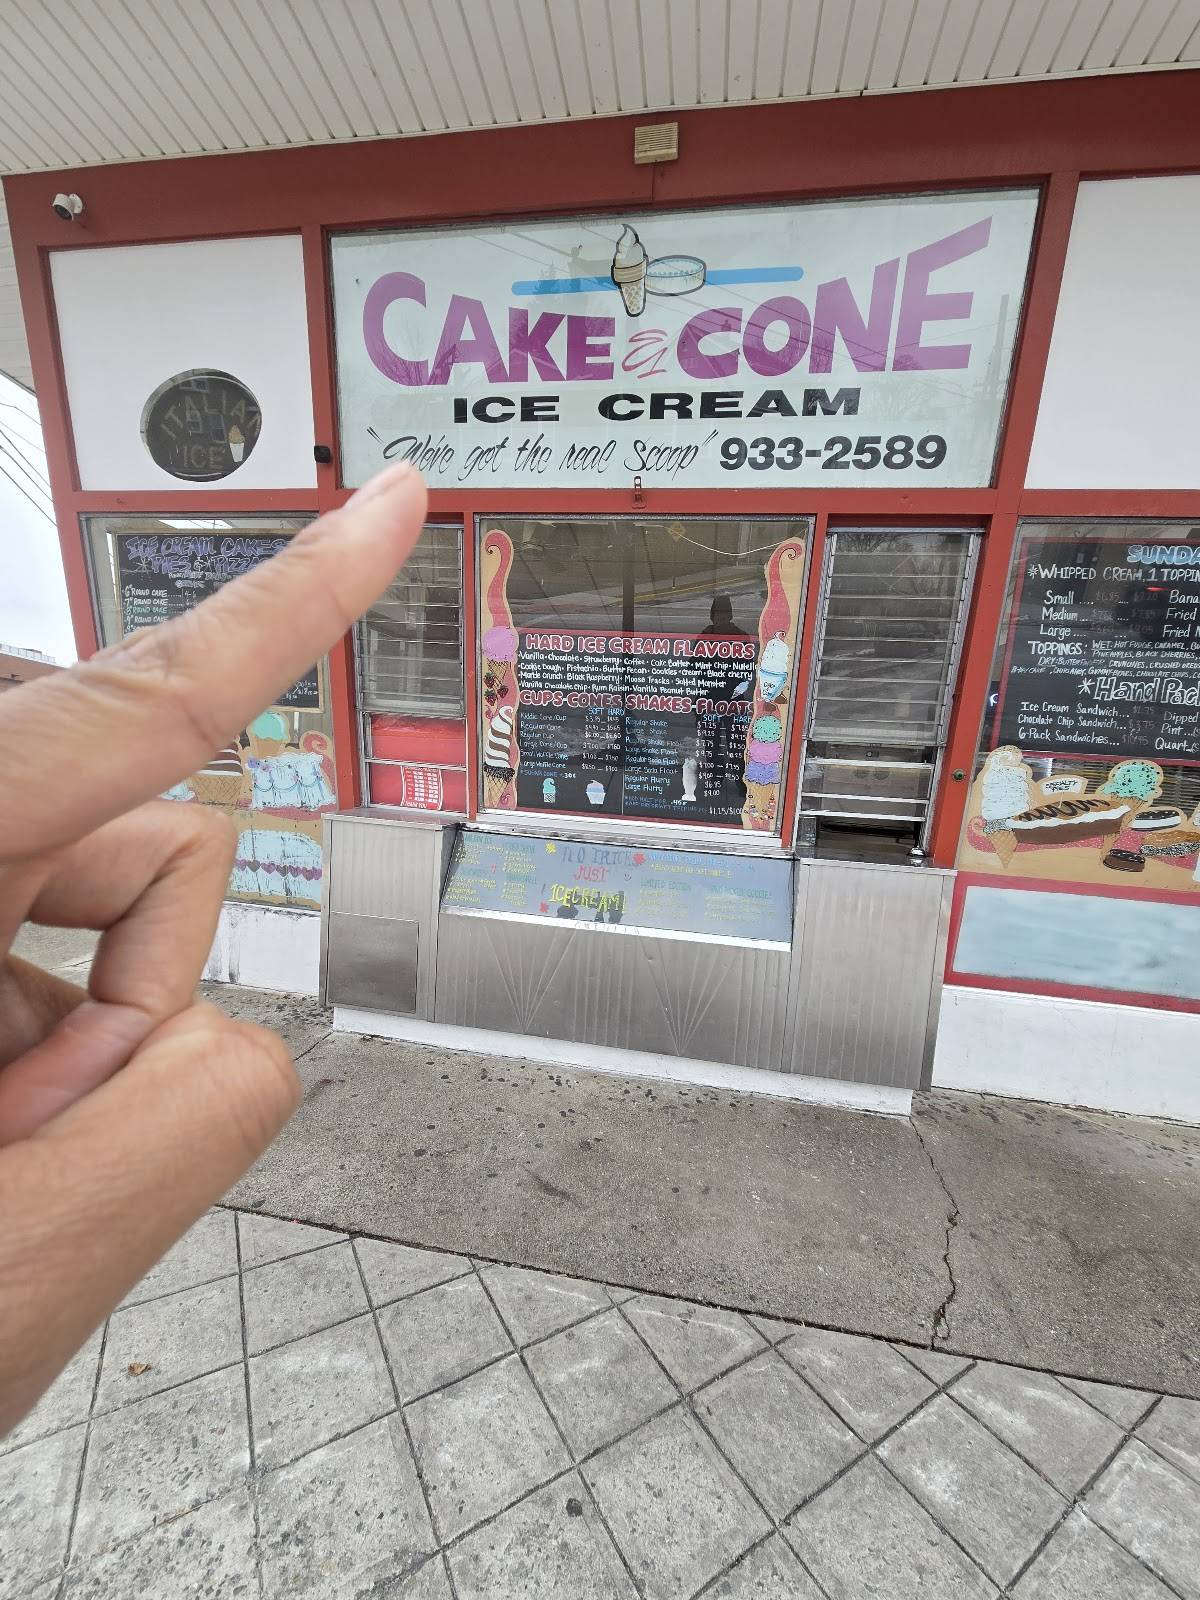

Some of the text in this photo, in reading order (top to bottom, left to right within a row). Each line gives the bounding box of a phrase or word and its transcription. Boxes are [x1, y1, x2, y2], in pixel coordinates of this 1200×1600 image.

[362, 271, 615, 387] CAKE
[676, 216, 993, 379] CONE
[453, 387, 862, 424] ICE CREAM
[459, 437, 506, 479] got
[514, 433, 558, 475] the
[560, 433, 612, 476] real
[719, 435, 948, 472] 933-2589
[127, 536, 158, 560] ICE
[160, 536, 217, 556] CREAM
[151, 589, 167, 597] CAKE
[1043, 590, 1074, 605] Small
[152, 598, 168, 606] CAKE
[1041, 606, 1078, 621] Medium
[1165, 607, 1197, 621] Fried
[1040, 623, 1072, 640] Large
[1162, 624, 1191, 638] Fried
[526, 633, 756, 660] HARD ICE CREAM FLAVORS
[519, 651, 545, 661] Vanilla
[548, 652, 579, 662] Chocolate
[584, 655, 621, 665] Strawberry
[624, 658, 646, 666] Coffee
[651, 658, 667, 667] Cake
[668, 658, 691, 668] Batter
[695, 661, 713, 669] Mint
[714, 661, 730, 670] Chip
[1150, 661, 1180, 669] CRUSHED
[520, 662, 541, 671] Cookie
[543, 663, 562, 673] Dough
[567, 664, 599, 673] Pistachio
[603, 664, 626, 673] Butter
[627, 666, 648, 675] Pecan
[651, 666, 678, 676] Cookies
[706, 670, 726, 678] Black
[520, 671, 541, 680] Marble
[567, 673, 586, 681] Black
[586, 673, 620, 684] Raspberry
[624, 675, 646, 683] Moose
[647, 675, 670, 684] Tracks
[520, 680, 543, 689] Vanilla
[544, 682, 573, 690] Chocolate
[592, 683, 608, 692] Rum
[608, 684, 630, 692] Raisin
[631, 684, 657, 693] Vanilla
[660, 685, 683, 695] Peanut
[686, 686, 709, 696] Butter
[589, 707, 605, 716] SOFT
[608, 707, 625, 716] HARD
[1020, 702, 1039, 711] Ice
[1042, 702, 1070, 712] Cream
[1163, 710, 1199, 724] Dipped
[1018, 714, 1053, 725] Chocolate
[1057, 716, 1075, 728] Chip
[1018, 726, 1051, 741] 6-Pack
[624, 765, 642, 774] Large
[624, 774, 648, 783] Regular
[624, 782, 641, 791] Large
[591, 847, 640, 867] TRICK
[573, 864, 609, 882] JUST
